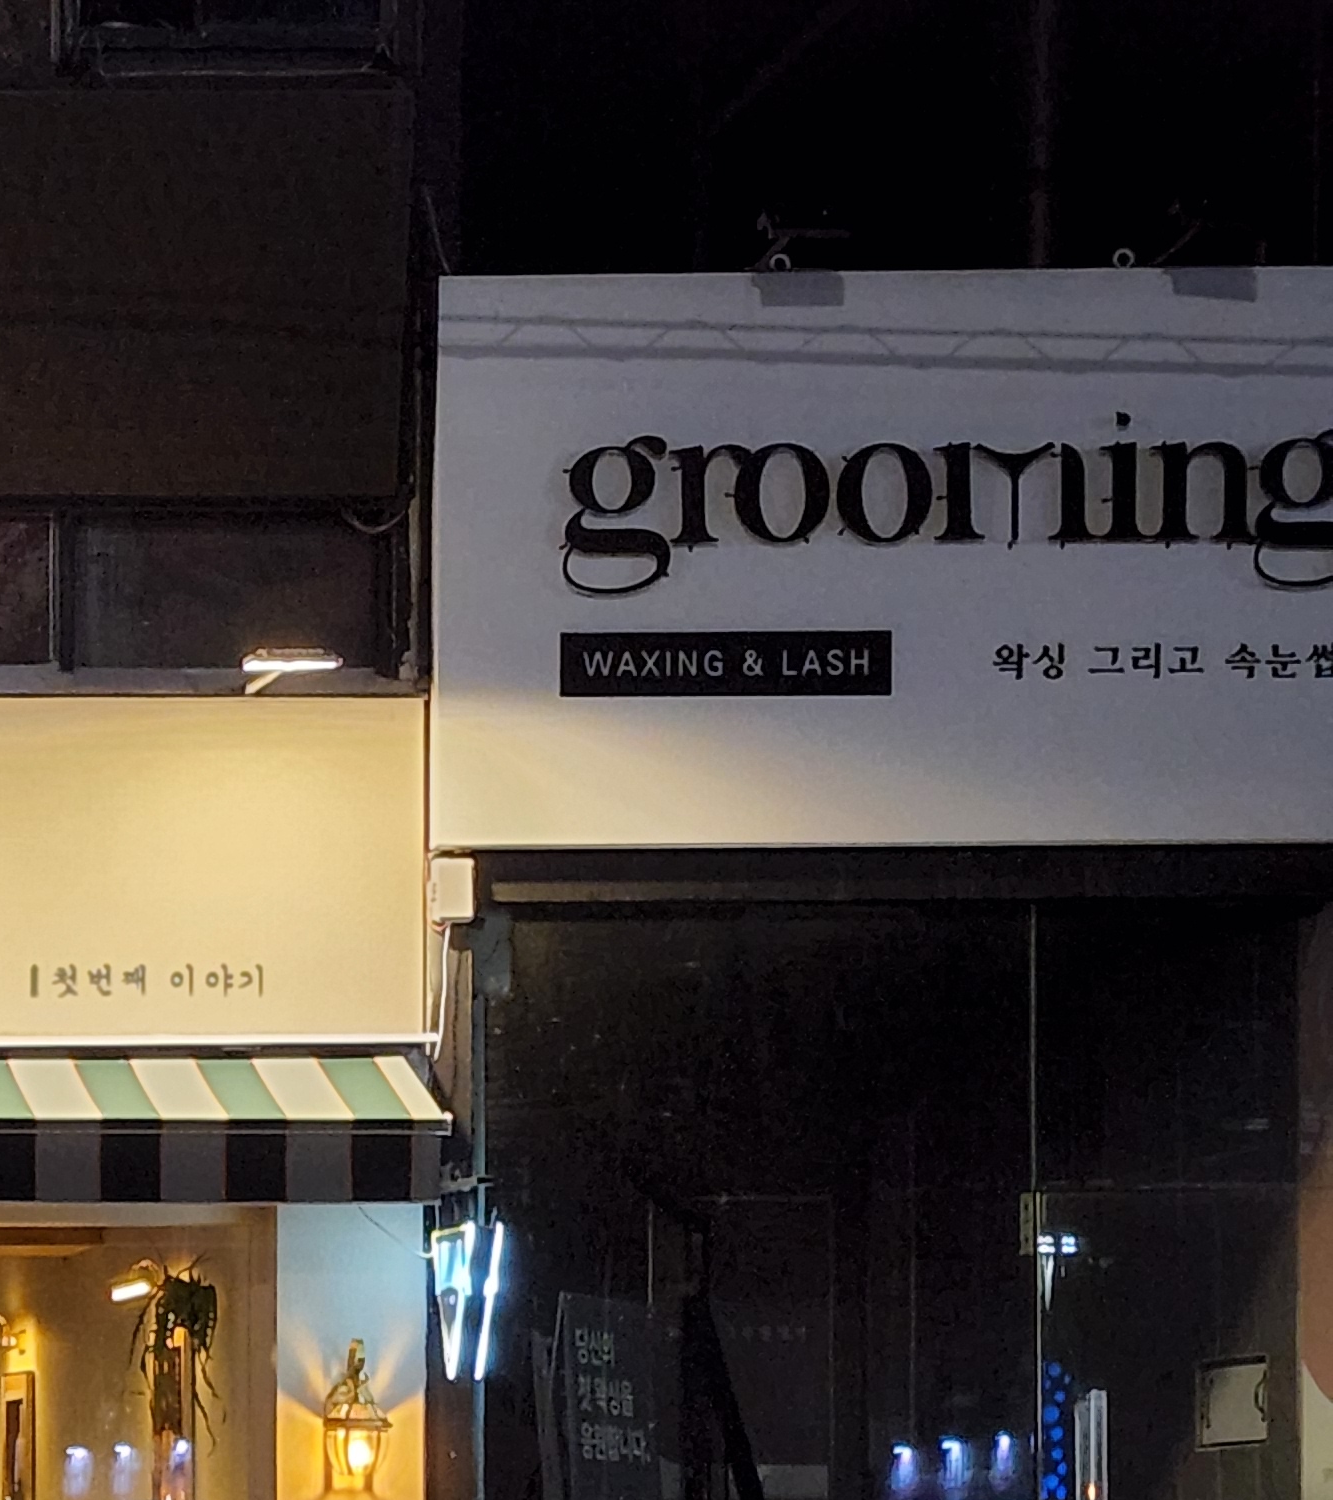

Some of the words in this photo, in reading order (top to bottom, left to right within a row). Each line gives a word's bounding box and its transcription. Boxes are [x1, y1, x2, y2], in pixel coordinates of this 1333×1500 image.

[561, 411, 1333, 597] grooming
[582, 649, 725, 678] WAXING
[741, 649, 765, 677] &
[780, 648, 871, 677] LASH
[992, 643, 1065, 680] 왁싱
[1088, 642, 1204, 679] 그리고
[51, 963, 146, 998] 첫번째
[169, 963, 265, 998] 이야기
